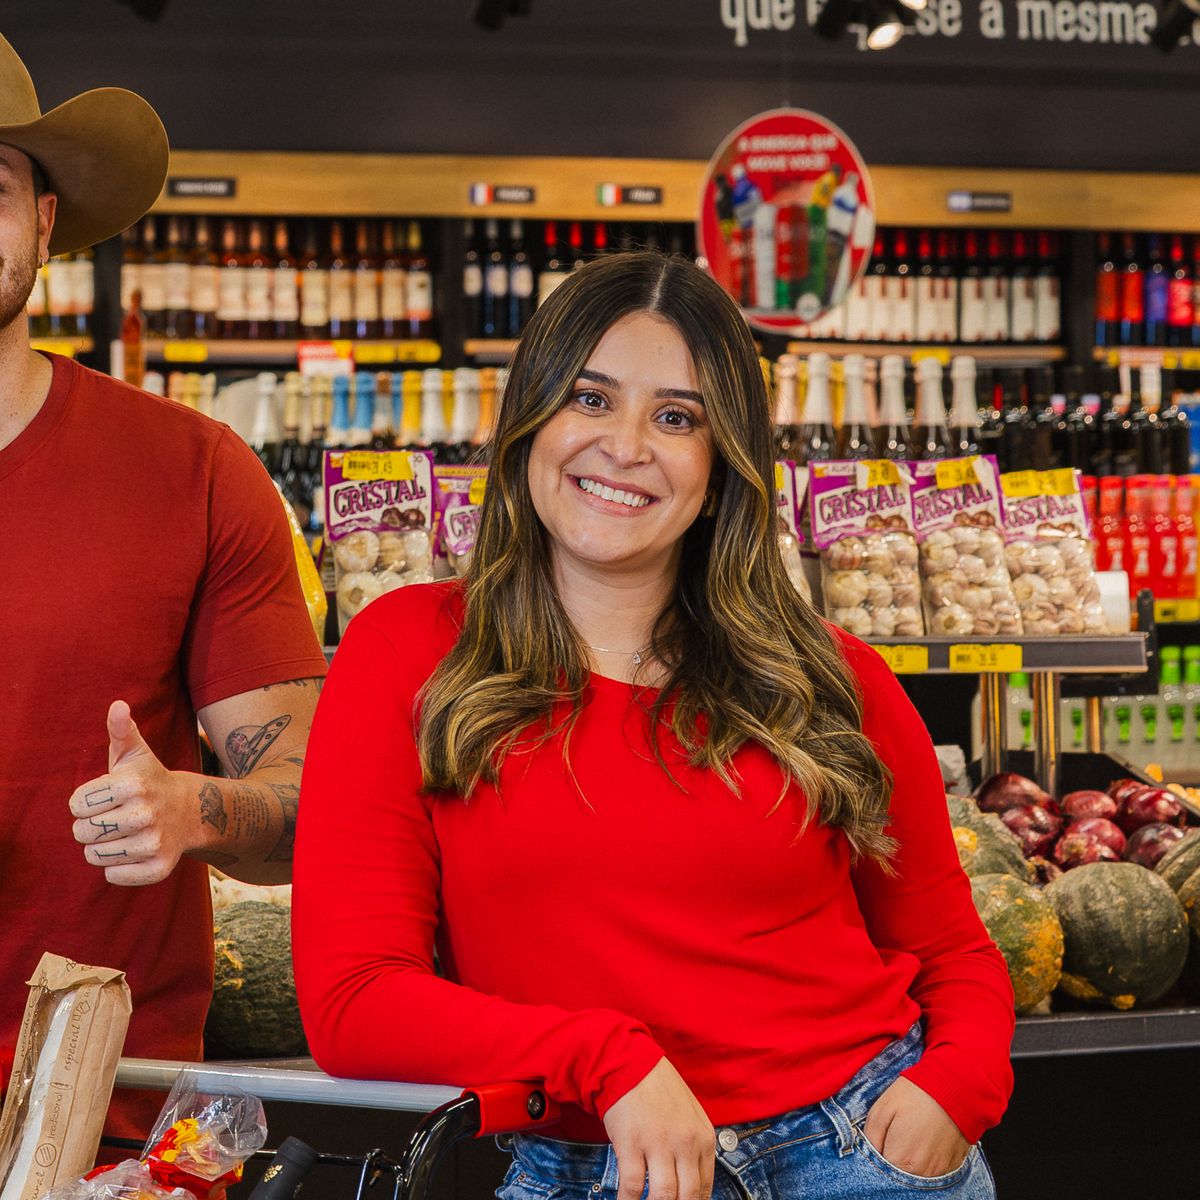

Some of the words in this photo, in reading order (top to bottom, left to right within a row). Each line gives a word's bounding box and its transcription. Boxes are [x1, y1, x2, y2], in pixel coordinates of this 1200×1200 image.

[720, 0, 796, 47] que
[979, 0, 1005, 39] a
[1016, 1, 1157, 45] mesma
[334, 475, 427, 518] CRISTAL
[820, 484, 906, 525] CRISTAL
[63, 1022, 82, 1073] especial
